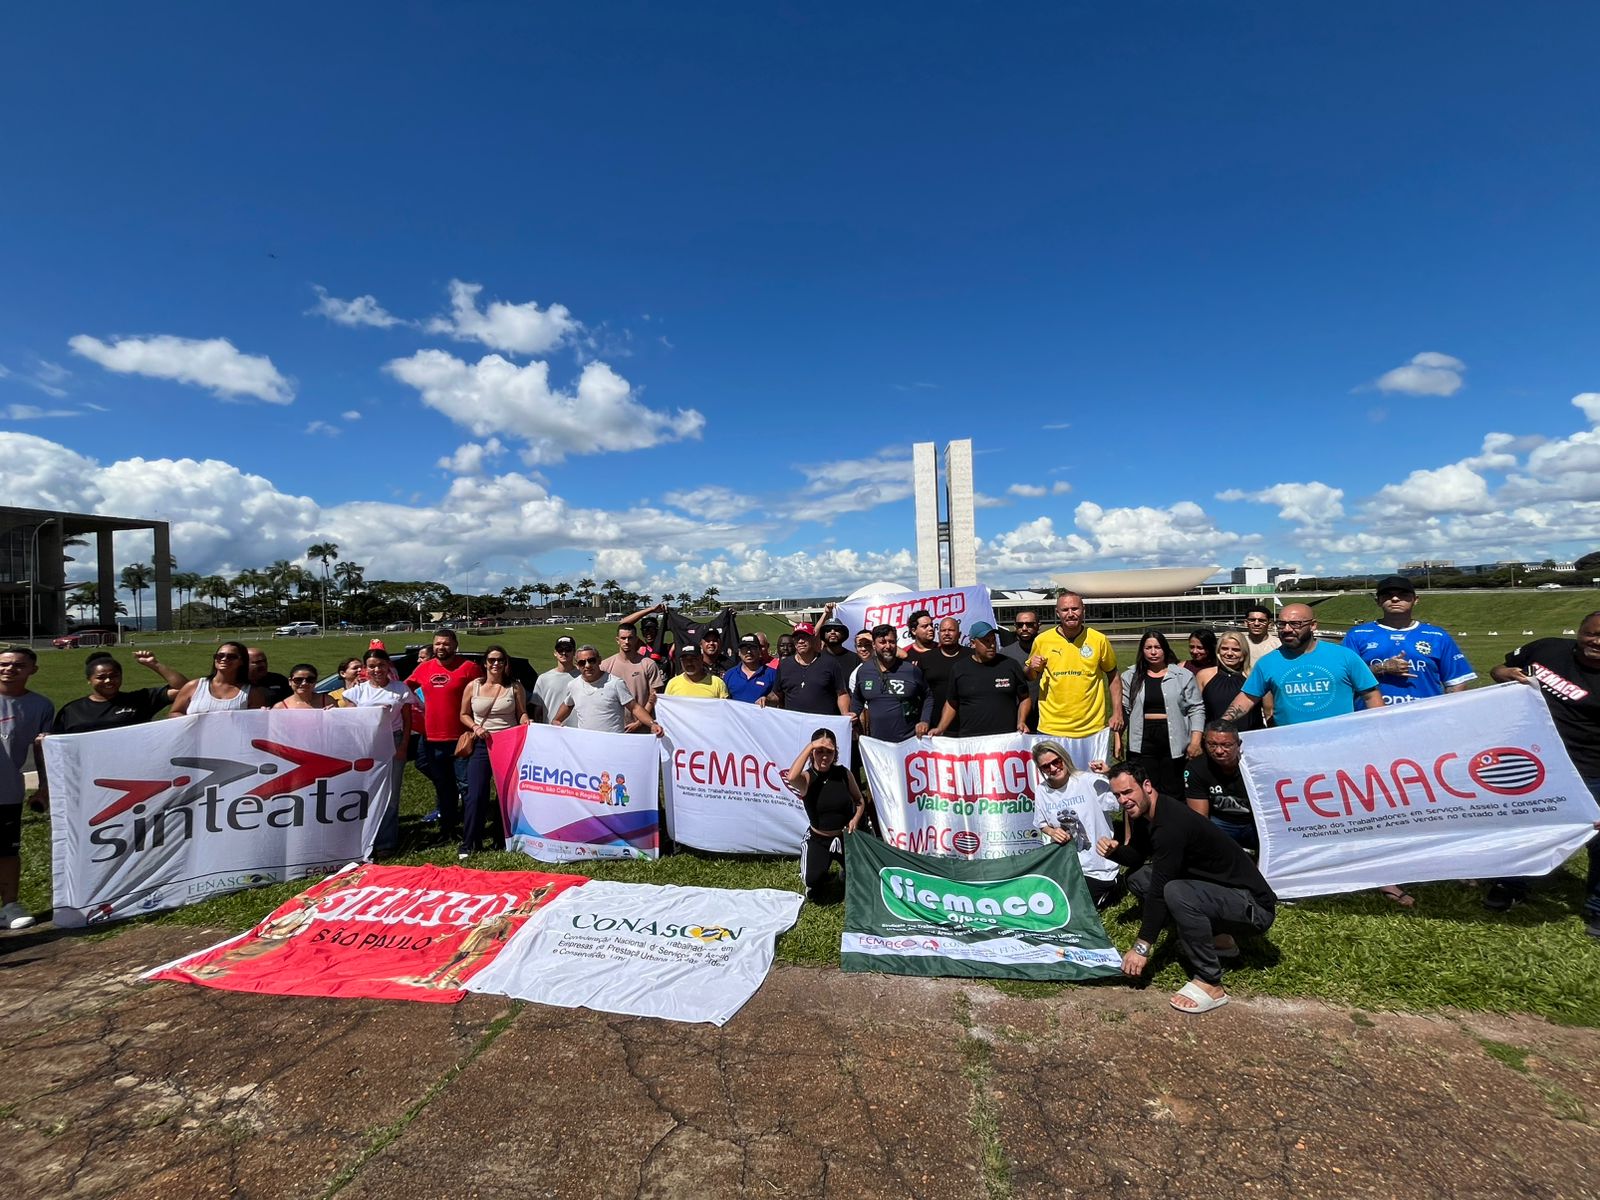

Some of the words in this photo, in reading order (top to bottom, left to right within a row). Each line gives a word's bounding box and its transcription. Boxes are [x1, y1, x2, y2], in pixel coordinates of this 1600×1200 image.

[1285, 681, 1331, 694] OAKLEY
[519, 764, 602, 791] SIEMACO
[1275, 746, 1546, 822] FEMACO
[706, 787, 742, 797] Trabalhadores
[916, 795, 949, 813] Vale
[952, 798, 975, 816] do
[1287, 822, 1328, 834] Federação
[1329, 821, 1345, 830] dos
[1348, 811, 1407, 827] Trabalhadores
[1409, 809, 1423, 818] em
[1469, 803, 1500, 811] Asseio
[1511, 795, 1567, 809] Conservação
[90, 779, 369, 863] sinteata
[1343, 825, 1374, 834] Urbana
[1413, 815, 1444, 824] Verdes
[1461, 810, 1493, 819] Estado
[1511, 808, 1530, 816] São
[1533, 804, 1558, 814] Paulo
[187, 871, 279, 895] FENASCON
[311, 927, 360, 947] SÃO
[359, 934, 433, 951] PAULO
[572, 913, 746, 942] CONASCON
[558, 940, 594, 950] Empresas
[614, 936, 647, 949] Nacional
